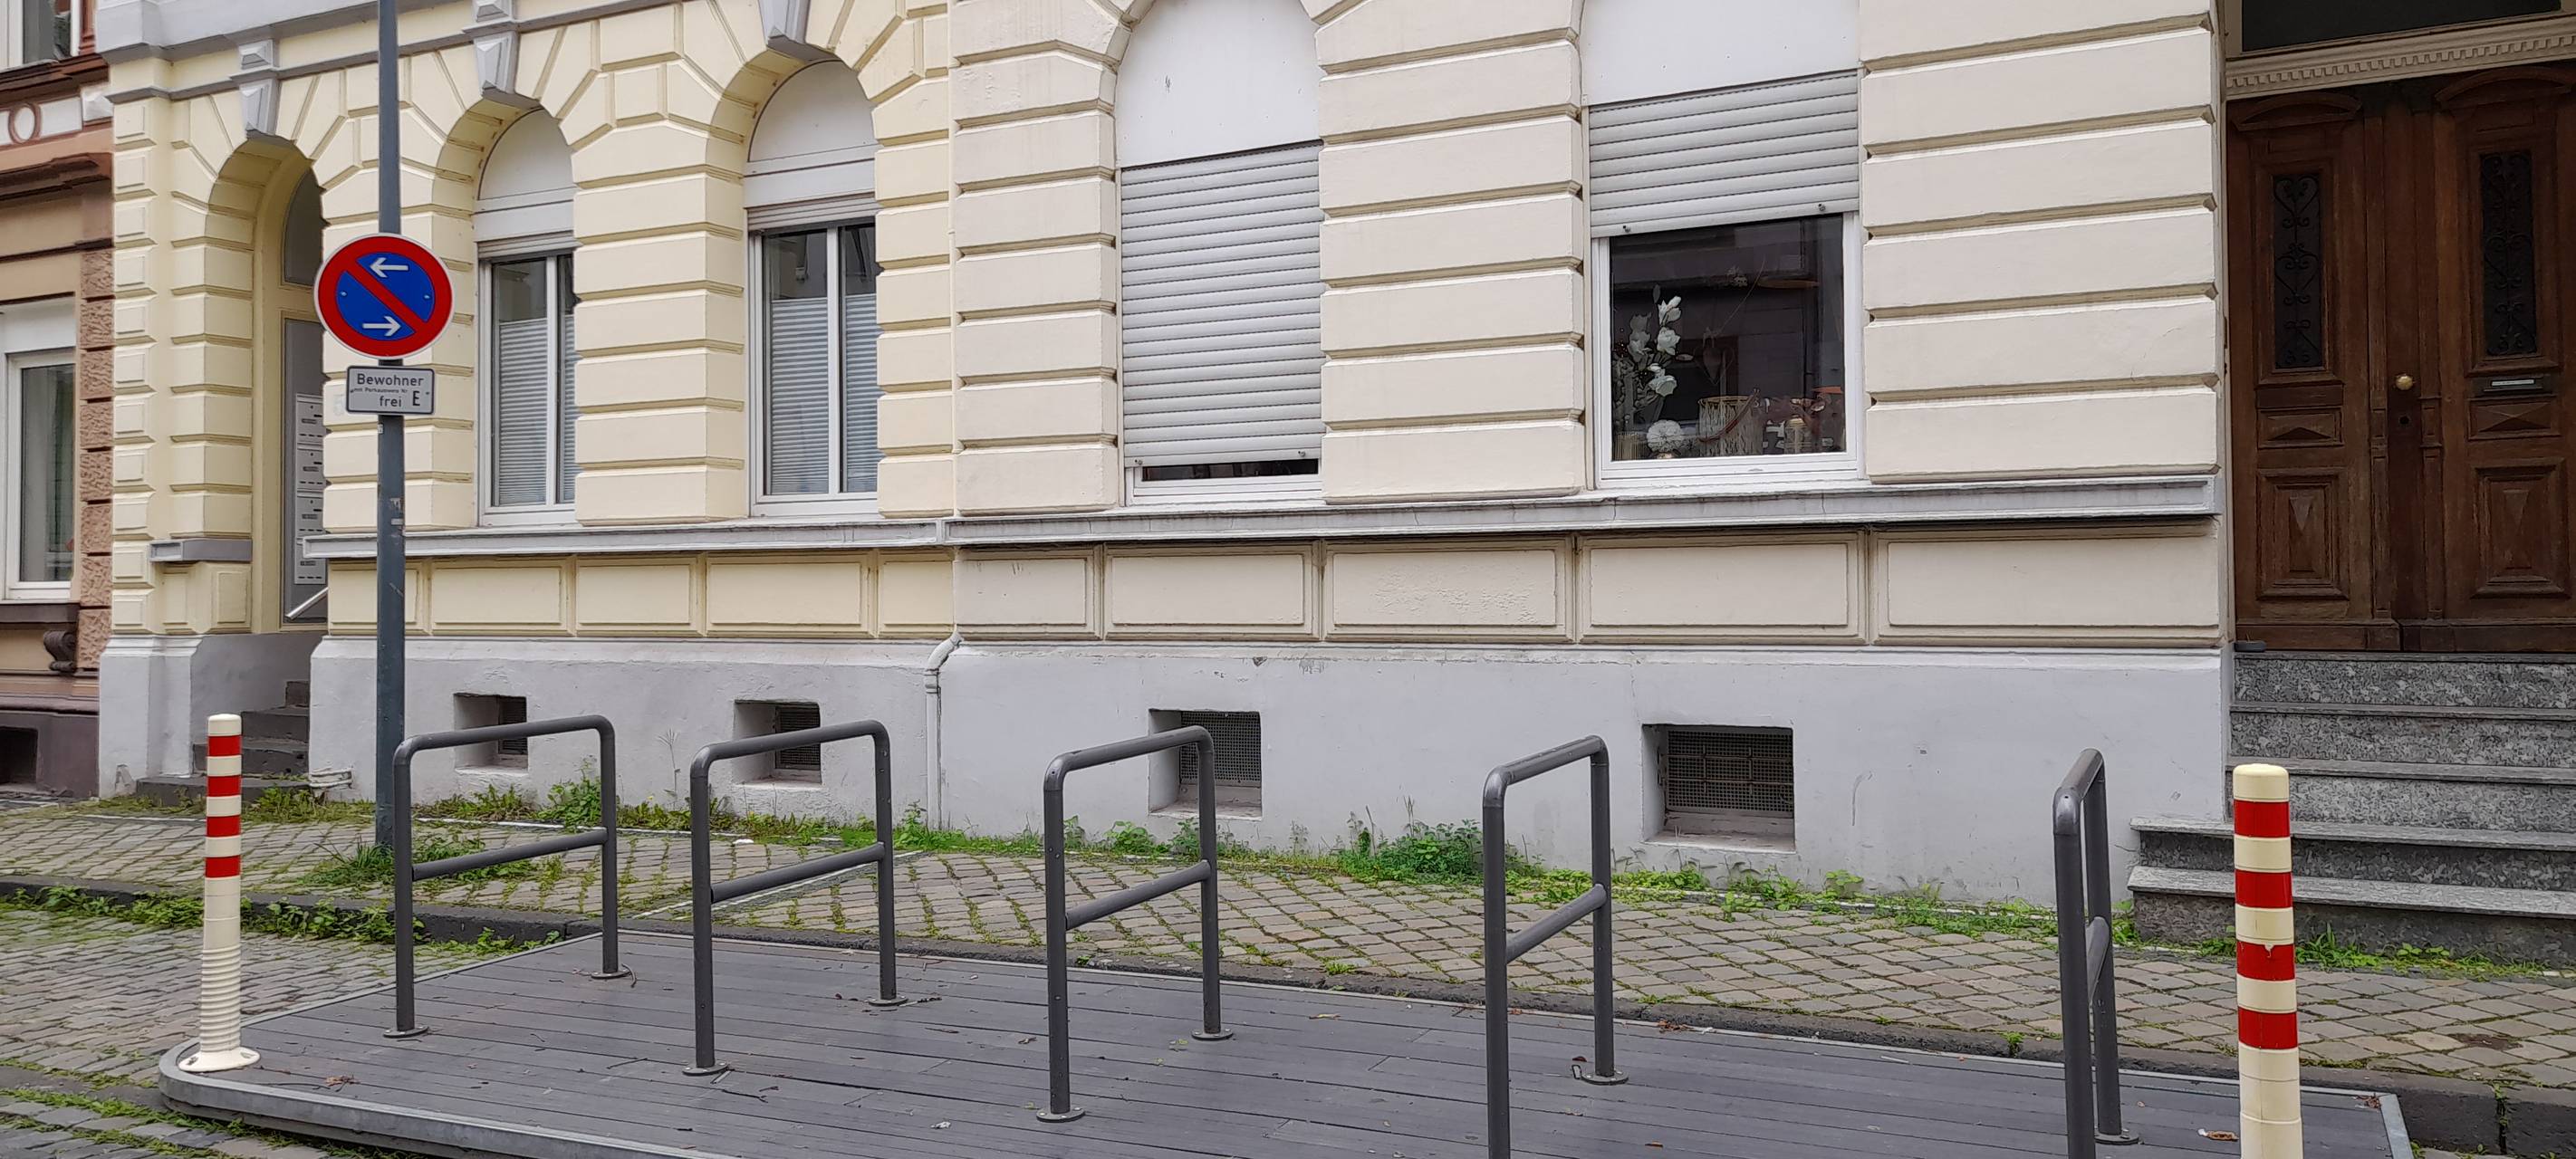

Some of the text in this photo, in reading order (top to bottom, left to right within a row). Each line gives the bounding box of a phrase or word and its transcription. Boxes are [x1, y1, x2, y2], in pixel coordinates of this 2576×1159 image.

[357, 373, 424, 386] Bewohner
[380, 390, 420, 407] frei E
